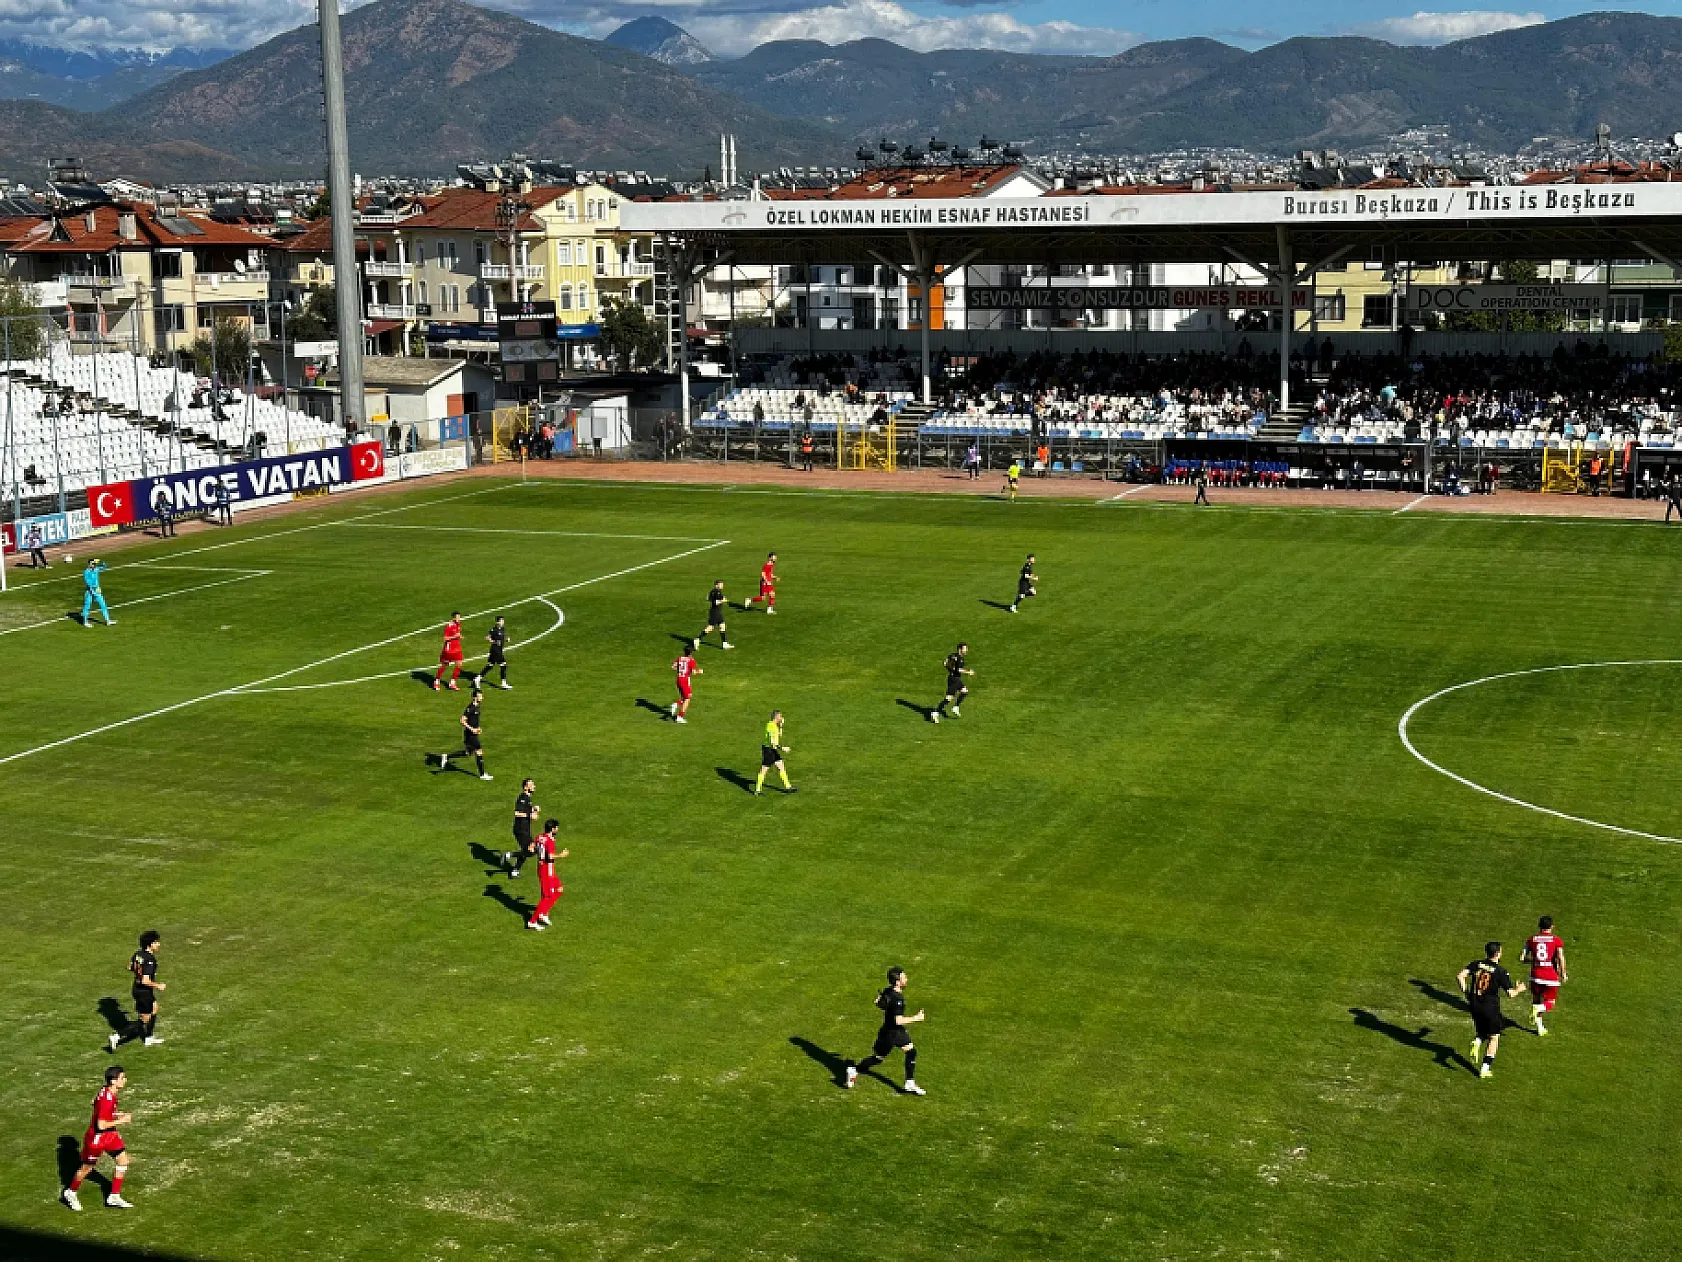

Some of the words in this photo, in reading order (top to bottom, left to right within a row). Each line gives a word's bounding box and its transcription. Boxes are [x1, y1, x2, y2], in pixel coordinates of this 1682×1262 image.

[766, 205, 806, 225] ÖZEL
[811, 208, 875, 225] LOKMAN
[880, 204, 932, 224] HEKİM
[937, 206, 991, 224] ESNAF
[996, 202, 1090, 222] HASTANESİ
[1284, 196, 1348, 216] Burası
[1355, 194, 1439, 220] Beşkaza
[1445, 192, 1455, 214] /
[1466, 190, 1512, 211] This
[1519, 190, 1538, 209] is
[1545, 188, 1636, 215] Beşkaza
[971, 289, 1051, 307] SEVDAMIZ
[1057, 288, 1168, 308] SONSUZDUR
[1236, 289, 1306, 306] REKLM
[1417, 287, 1476, 308] DOC
[1515, 286, 1564, 297] DENTAL
[1480, 297, 1550, 308] OPERATION
[246, 454, 341, 496] VATAN
[1536, 943, 1549, 962] 8
